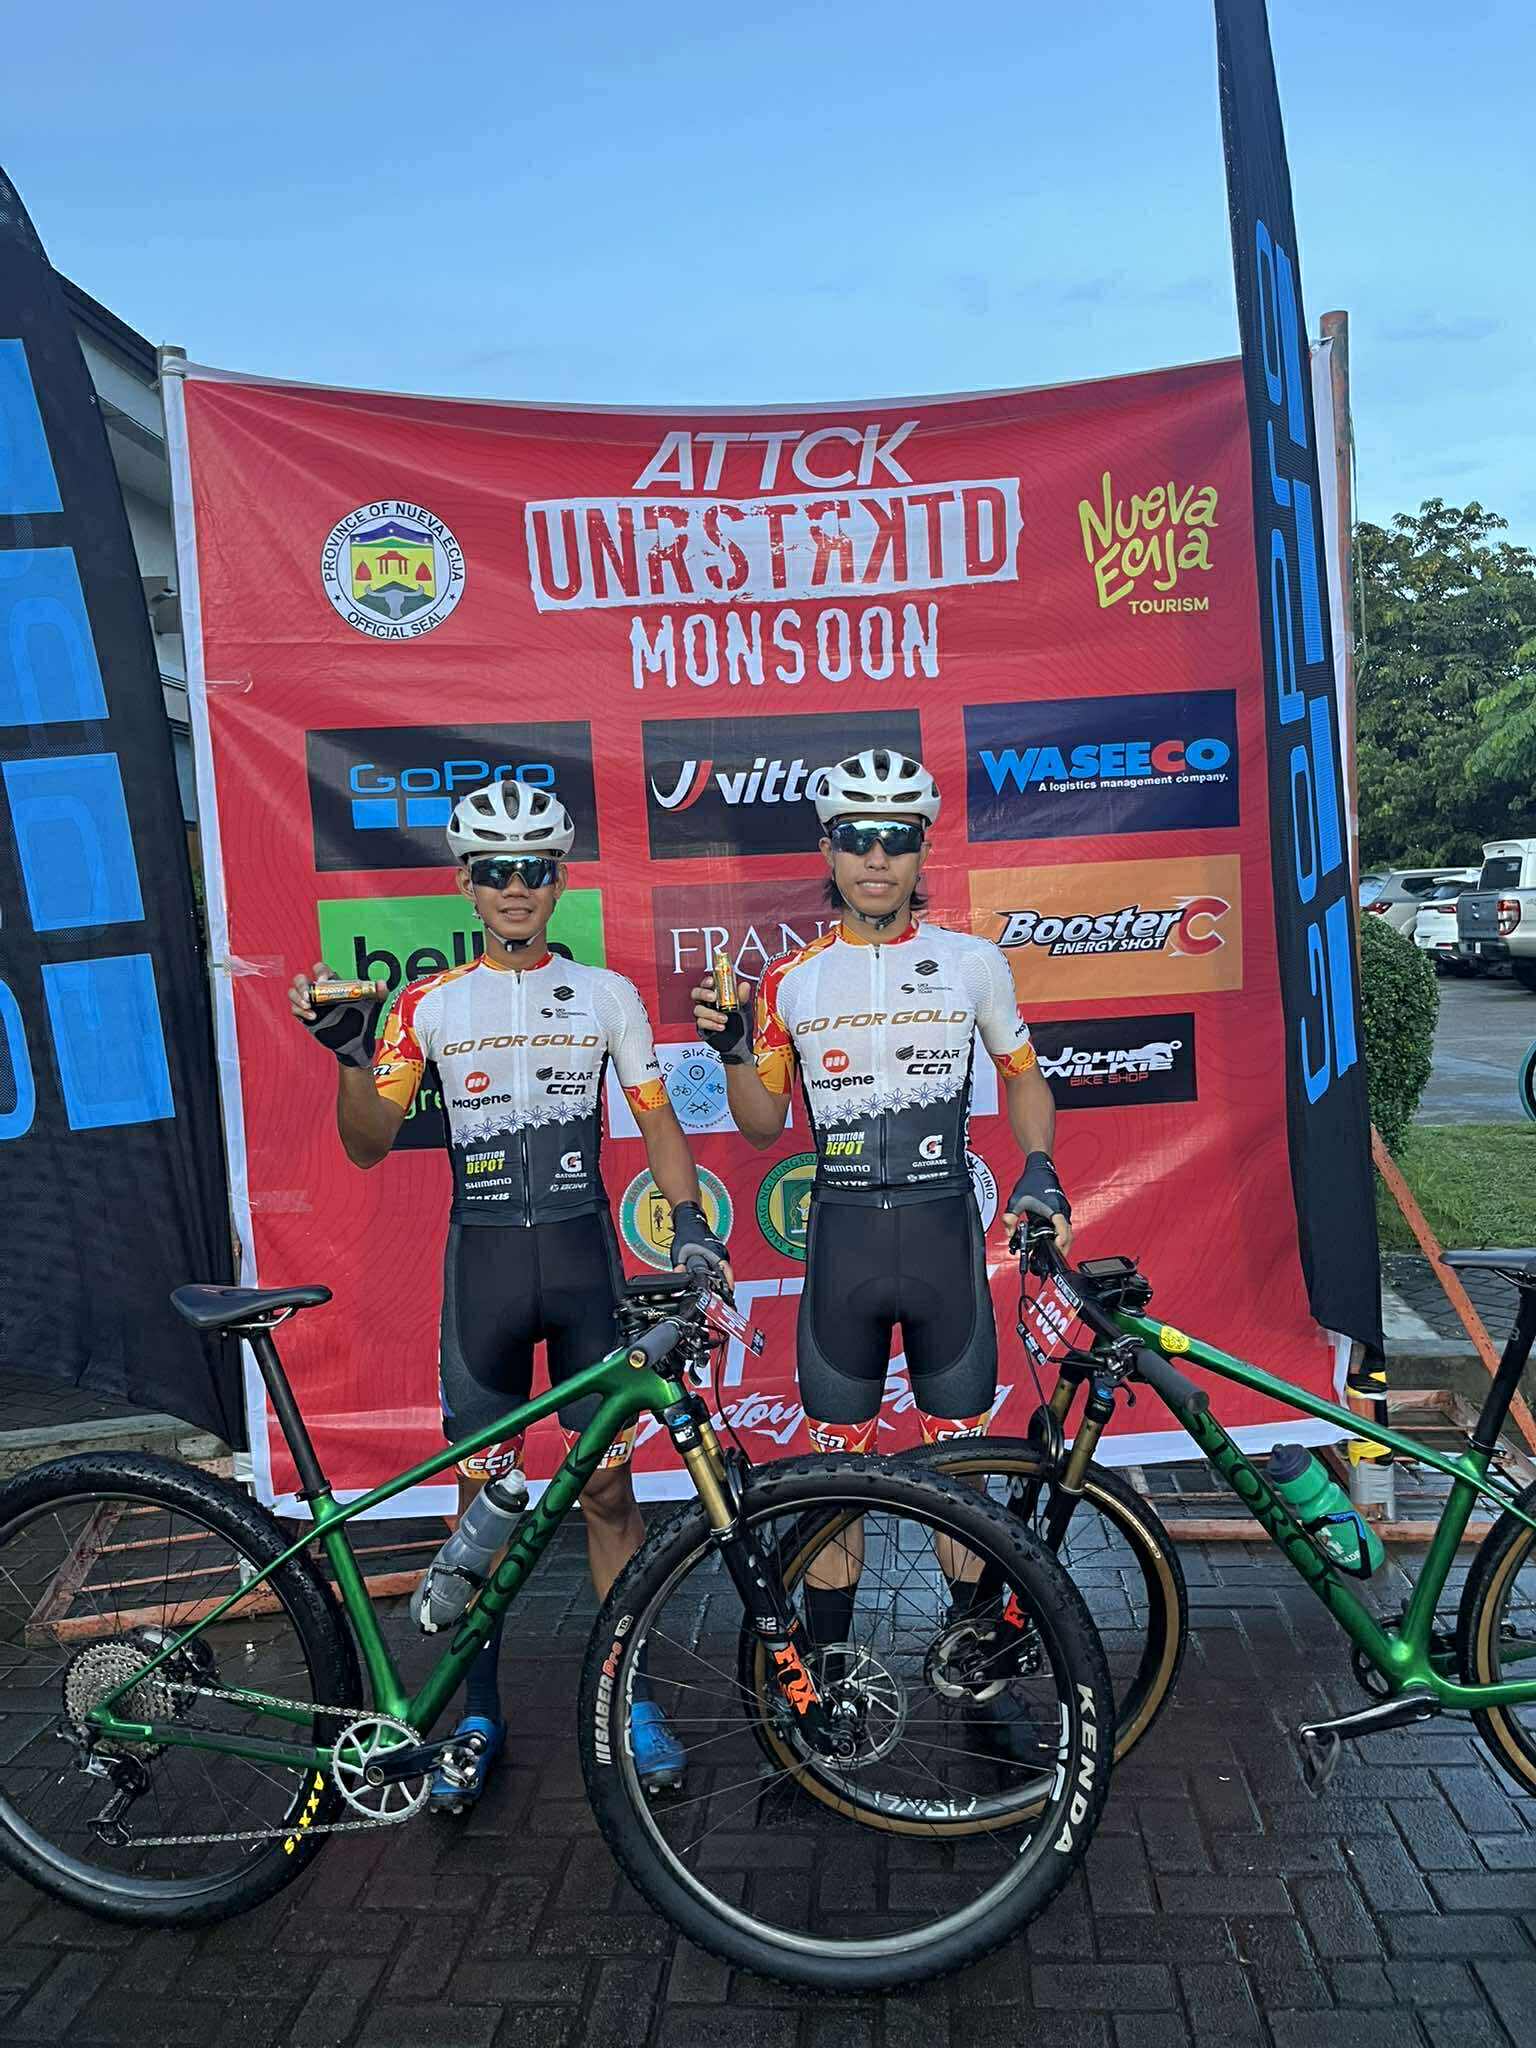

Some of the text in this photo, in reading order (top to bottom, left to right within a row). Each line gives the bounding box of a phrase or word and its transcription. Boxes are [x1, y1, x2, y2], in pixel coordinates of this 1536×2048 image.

[633, 421, 920, 490] ATTCK
[1079, 471, 1218, 563] Nueva
[323, 502, 463, 582] PROVINCE OF NUEVA ECIJA
[1128, 597, 1209, 615] TOURISM
[347, 611, 446, 638] OFFICIAL SEAL
[629, 603, 940, 689] MONSOON
[350, 760, 556, 793] GoPro
[979, 738, 1231, 796] WASEECO
[1039, 773, 1229, 793] A logistics management company.
[1052, 938, 1163, 955] ENERGY SHOT
[796, 1009, 968, 1036] GO FOR GOLD
[443, 1034, 599, 1056] GO FOR GOLD
[811, 1074, 875, 1091] Magene
[1070, 1072, 1149, 1087] BIKE SHOP
[452, 1093, 512, 1110] Magene
[825, 1140, 865, 1156] DEPOT
[466, 1158, 506, 1175] DEPOT
[823, 1164, 871, 1173] SHIMANO
[465, 1177, 512, 1190] SHIMANO
[980, 1169, 995, 1200] TINIO
[756, 1617, 777, 1631] 32
[1054, 1682, 1097, 1853] KENDA
